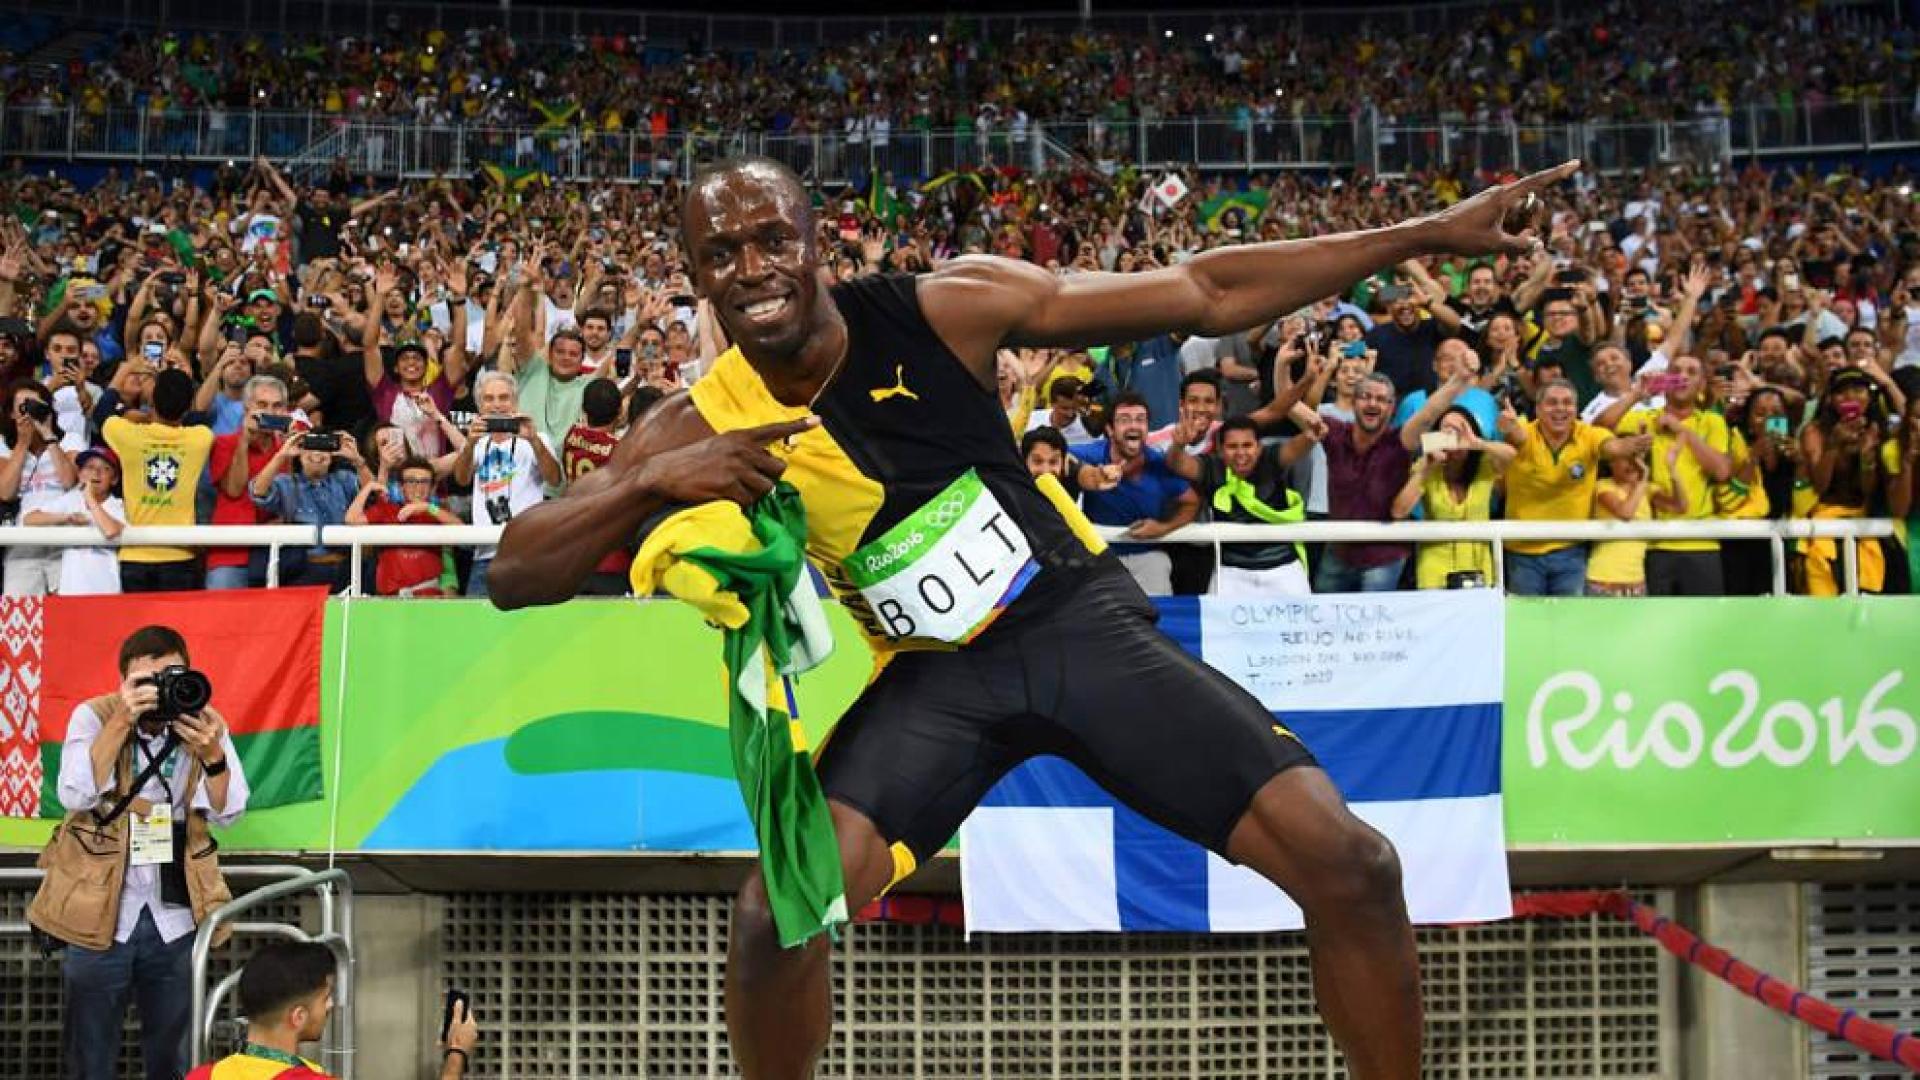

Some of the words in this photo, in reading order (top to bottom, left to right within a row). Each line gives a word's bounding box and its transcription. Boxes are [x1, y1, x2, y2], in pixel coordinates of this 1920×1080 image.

[866, 530, 923, 572] Rio2016
[878, 511, 1017, 643] BOLT
[1231, 603, 1322, 625] OLYMPIC
[1334, 604, 1395, 624] TOUR
[1526, 669, 1918, 770] Rio2016
